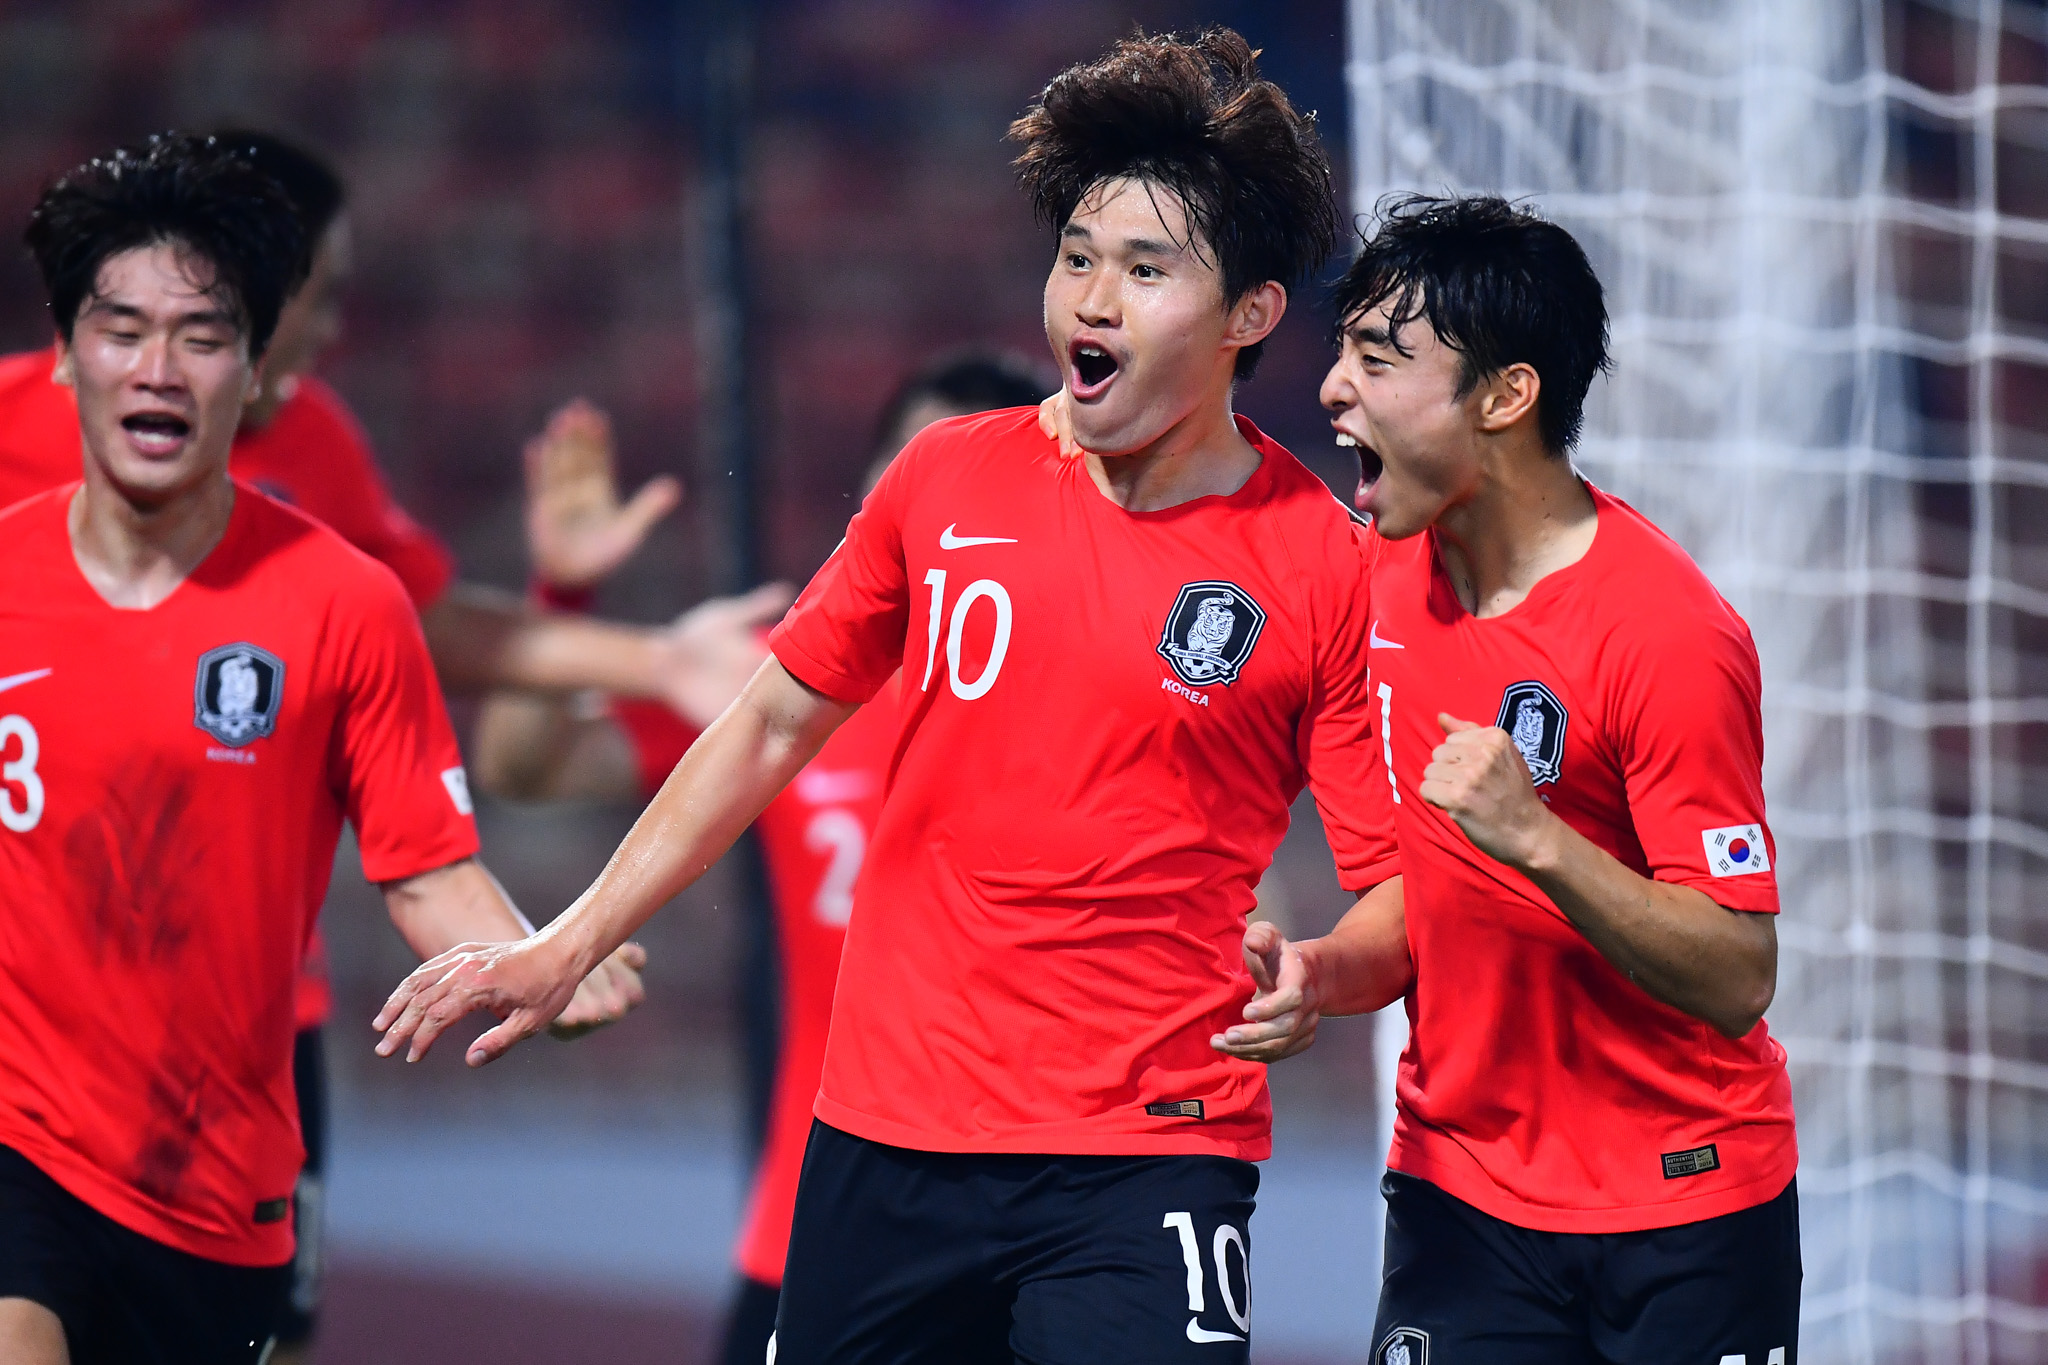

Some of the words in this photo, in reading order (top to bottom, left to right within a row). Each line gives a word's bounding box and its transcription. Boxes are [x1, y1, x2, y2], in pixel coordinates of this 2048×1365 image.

[920, 568, 1013, 701] 10
[1161, 678, 1209, 707] KOREA
[1366, 666, 1402, 805] 1
[806, 809, 867, 926] 2
[1162, 1211, 1250, 1333] 10
